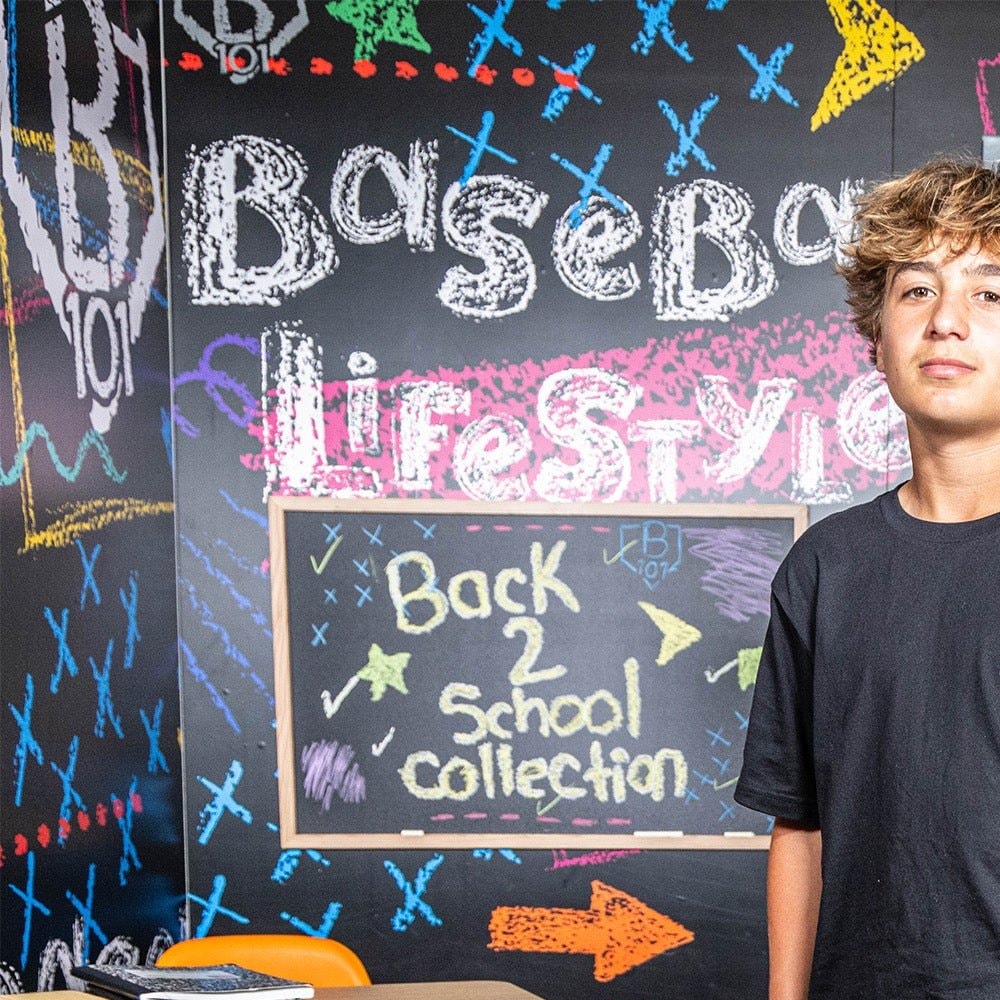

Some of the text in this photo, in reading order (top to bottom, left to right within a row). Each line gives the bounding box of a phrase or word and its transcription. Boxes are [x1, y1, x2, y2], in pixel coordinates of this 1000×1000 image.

[214, 43, 269, 74] 101
[66, 291, 134, 399] 101
[642, 520, 668, 559] B
[637, 559, 669, 581] 101
[502, 616, 568, 686] 2
[439, 656, 642, 746] School
